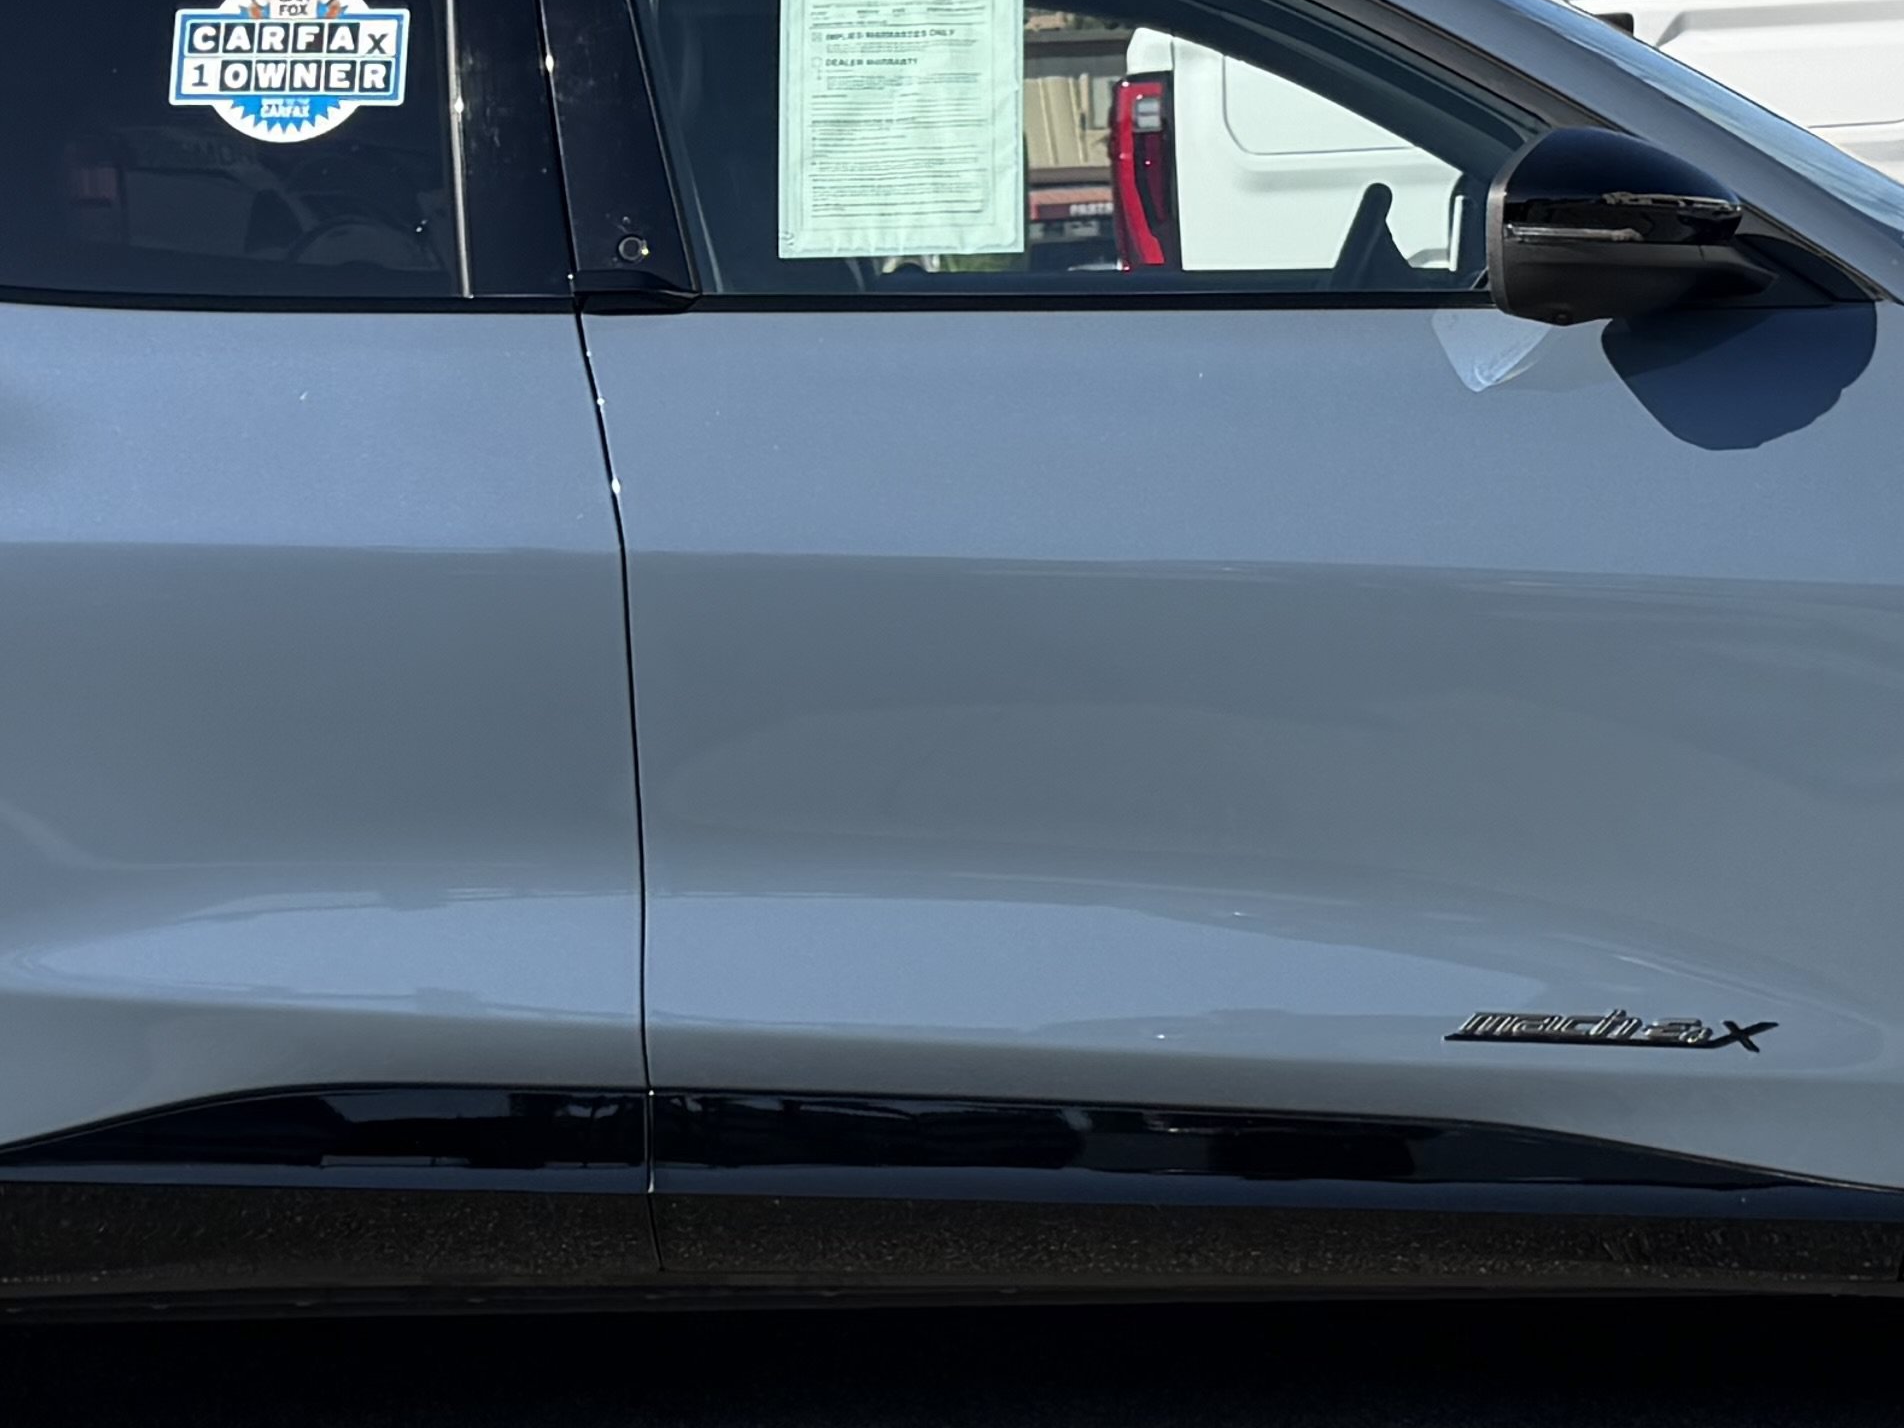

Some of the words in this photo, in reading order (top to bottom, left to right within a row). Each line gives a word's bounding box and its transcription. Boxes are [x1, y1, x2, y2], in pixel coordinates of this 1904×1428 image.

[279, 3, 309, 16] FOX
[191, 24, 389, 55] CARFAX
[191, 63, 209, 87] 1
[223, 62, 388, 89] OWNER
